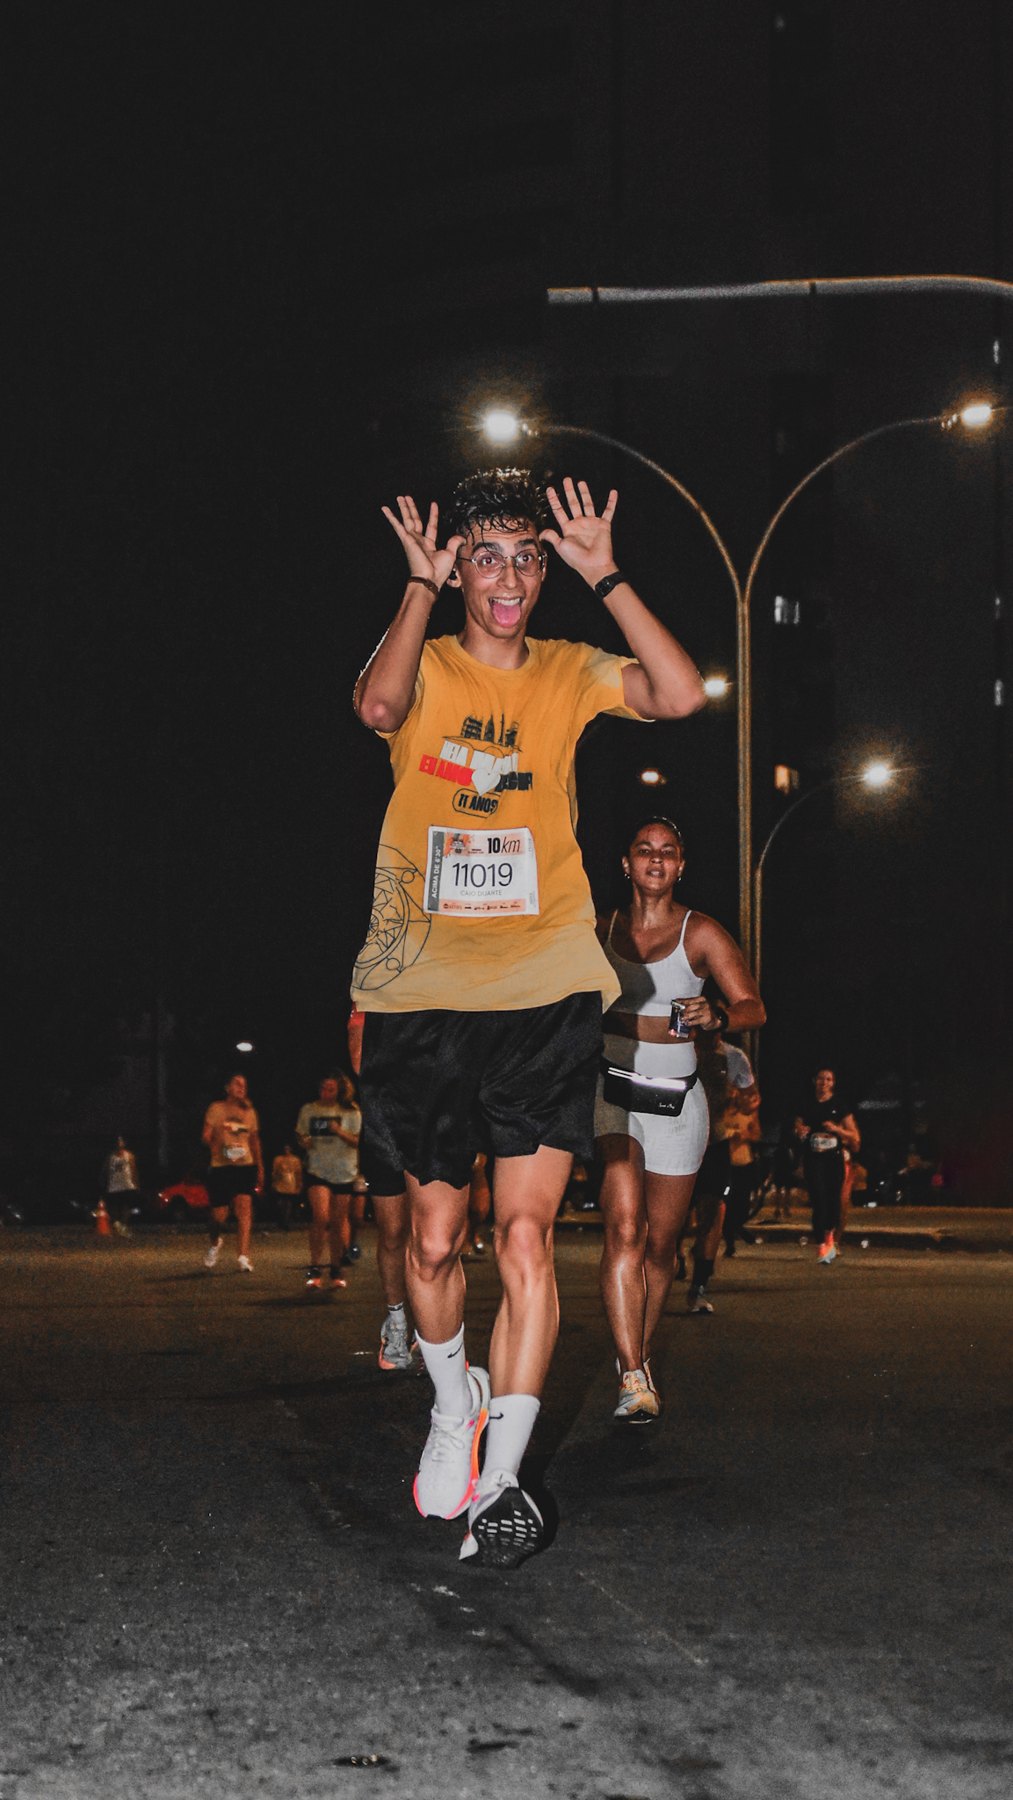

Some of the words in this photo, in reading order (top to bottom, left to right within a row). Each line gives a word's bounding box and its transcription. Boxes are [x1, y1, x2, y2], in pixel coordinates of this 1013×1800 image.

[469, 795, 498, 813] ANOS
[433, 863, 440, 874] DE
[452, 862, 513, 888] 11019
[431, 875, 439, 898] ACIMA
